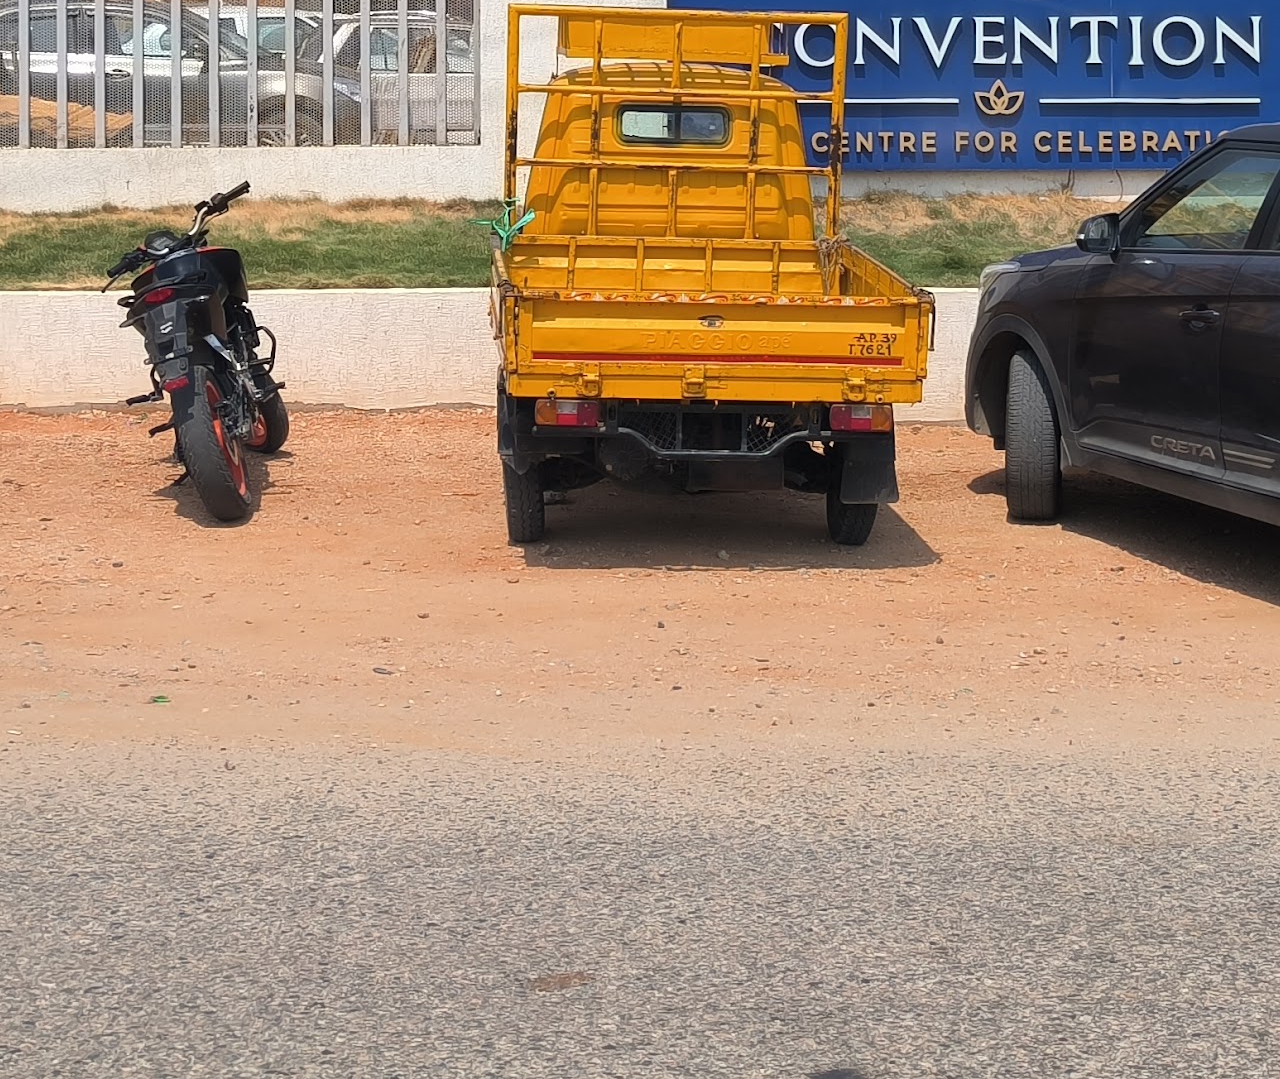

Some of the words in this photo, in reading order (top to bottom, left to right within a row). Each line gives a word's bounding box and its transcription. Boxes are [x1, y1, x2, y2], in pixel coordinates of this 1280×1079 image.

[773, 16, 1263, 69] ONVENTION
[811, 130, 937, 153] CENTRE
[955, 130, 1018, 153] FOR
[1034, 130, 1229, 153] CELEBRATI
[640, 331, 753, 351] PIAGGIO
[1150, 435, 1216, 460] CRETA
